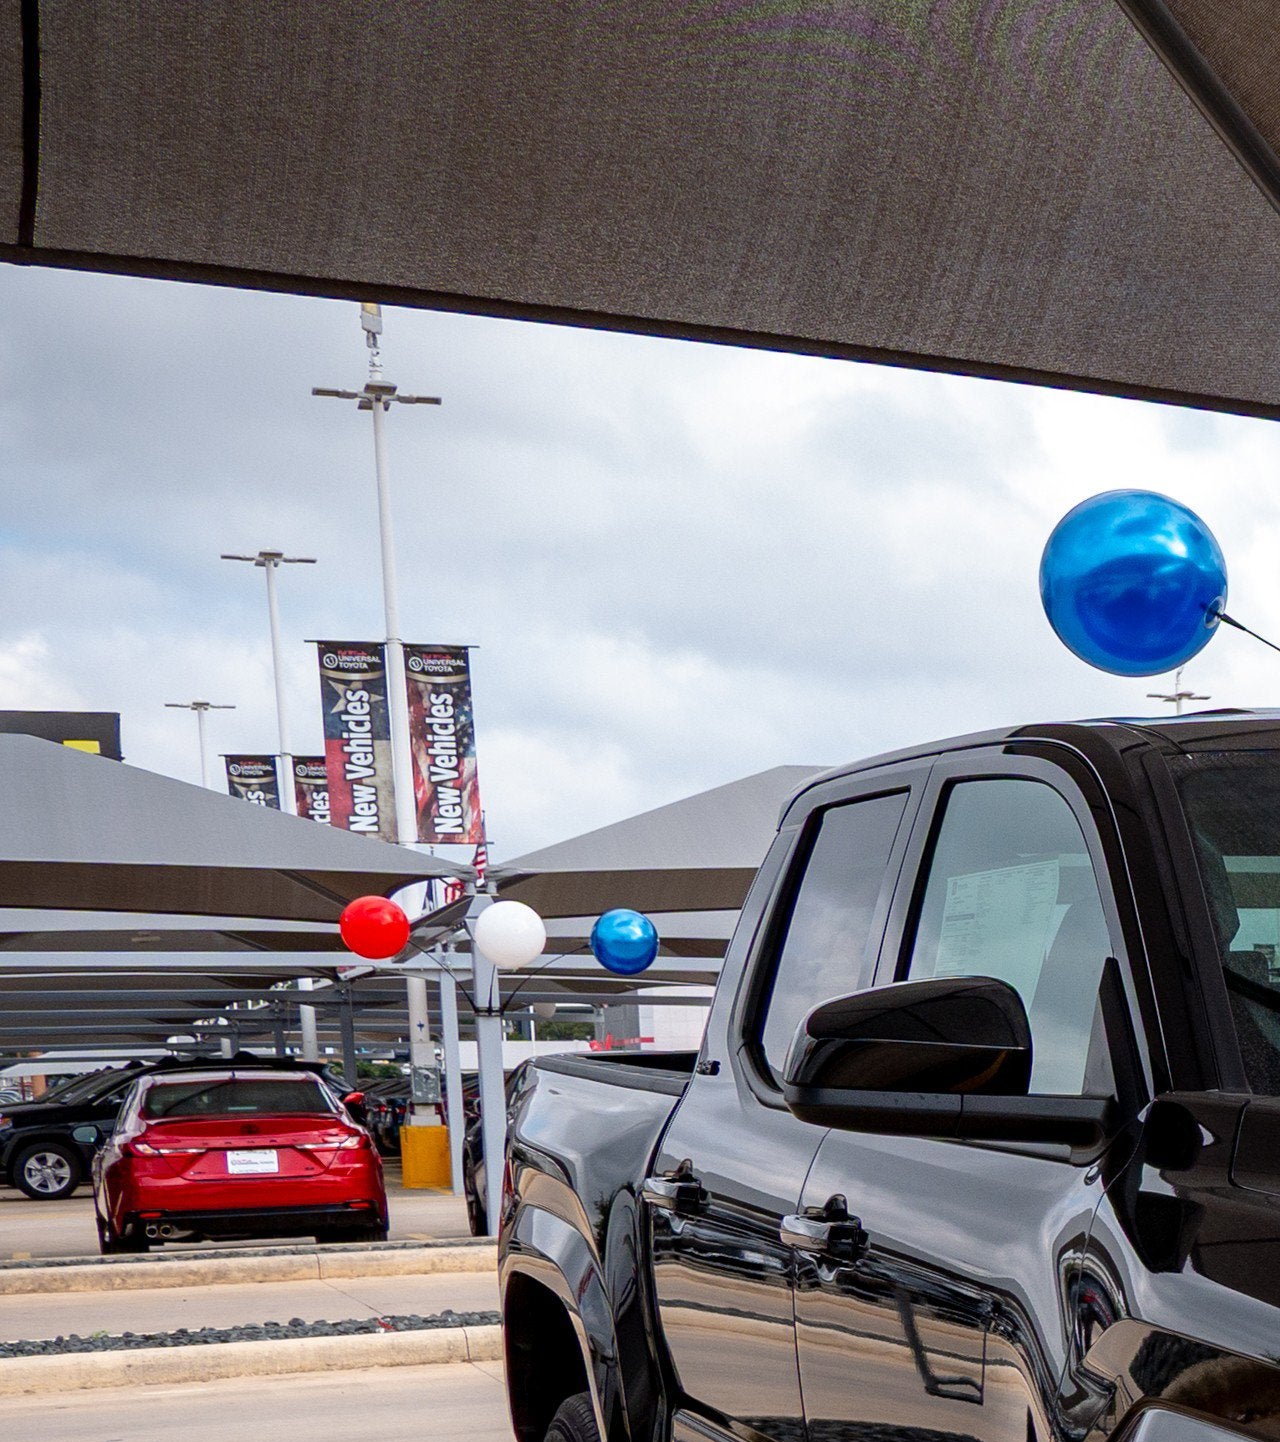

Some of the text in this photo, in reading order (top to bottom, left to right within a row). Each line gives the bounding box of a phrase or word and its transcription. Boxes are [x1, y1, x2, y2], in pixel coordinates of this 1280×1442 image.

[338, 655, 381, 663] UNIVERSAL
[423, 658, 466, 666] UNIVERSAL
[341, 689, 376, 781] Vehicles
[425, 692, 460, 783] Vehicles
[349, 784, 380, 833] New
[434, 787, 464, 834] New
